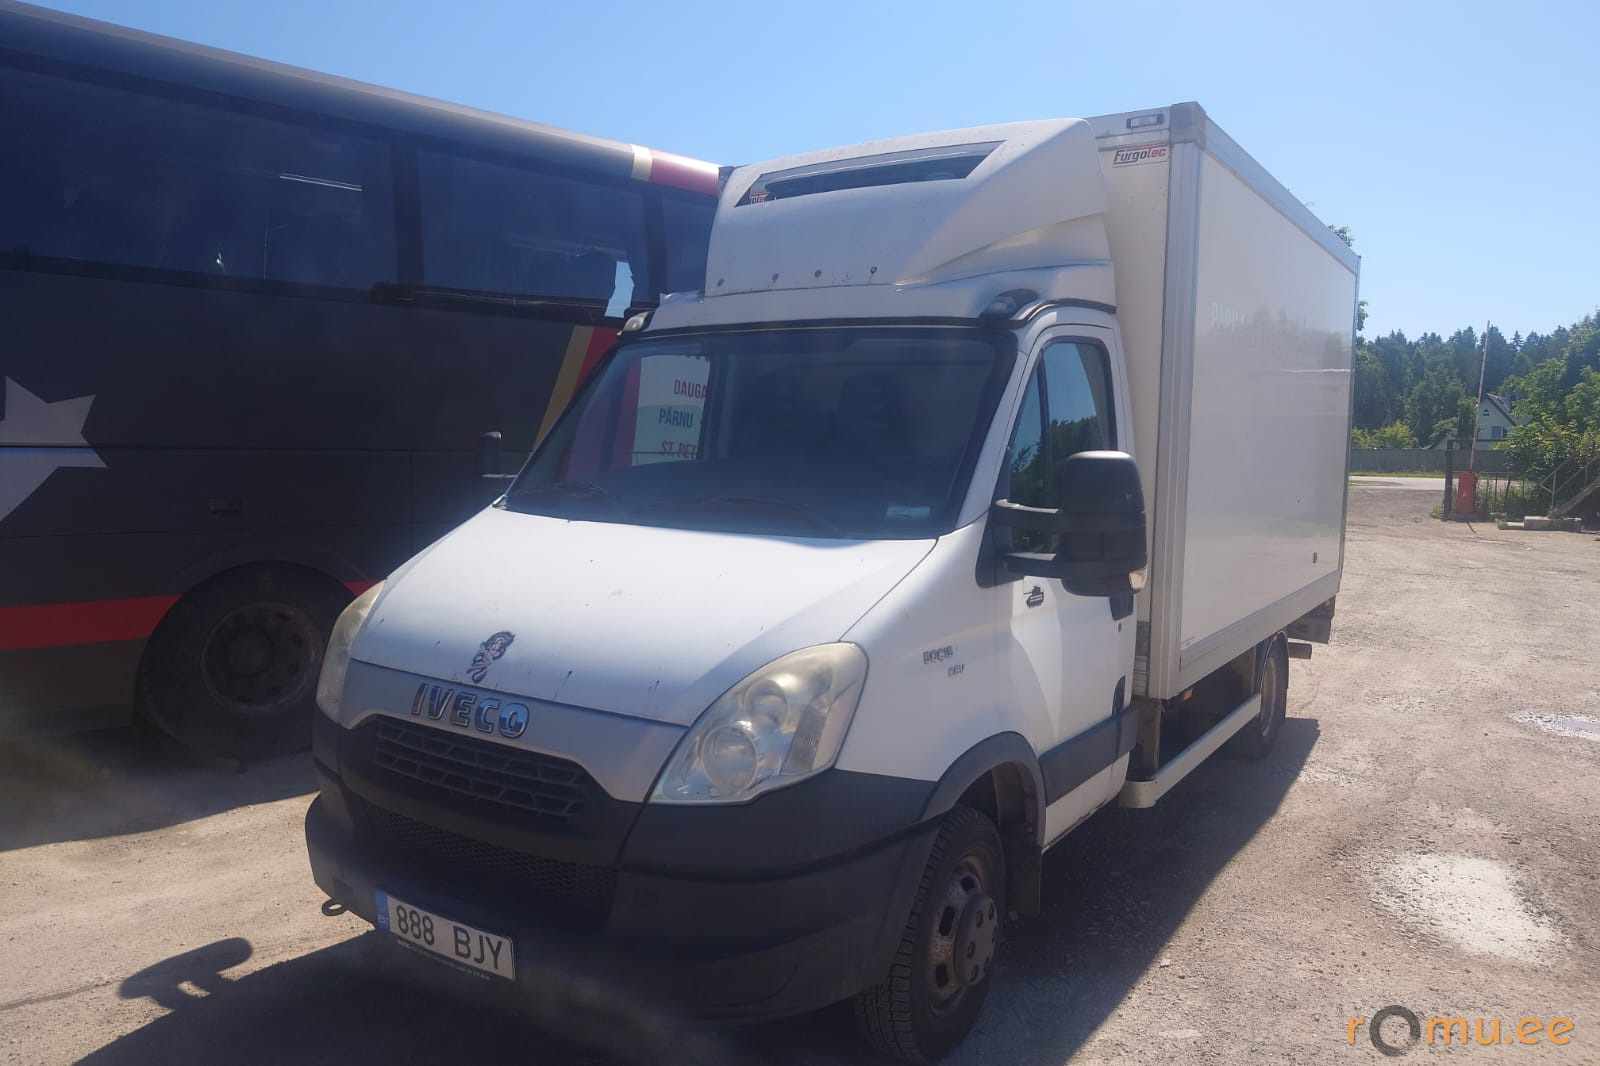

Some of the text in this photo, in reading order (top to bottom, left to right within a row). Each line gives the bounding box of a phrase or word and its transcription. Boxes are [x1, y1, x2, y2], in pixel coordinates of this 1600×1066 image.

[659, 407, 693, 428] PÄRNU
[412, 683, 529, 738] IVECO
[396, 904, 435, 946] 888
[453, 925, 502, 969] BJY
